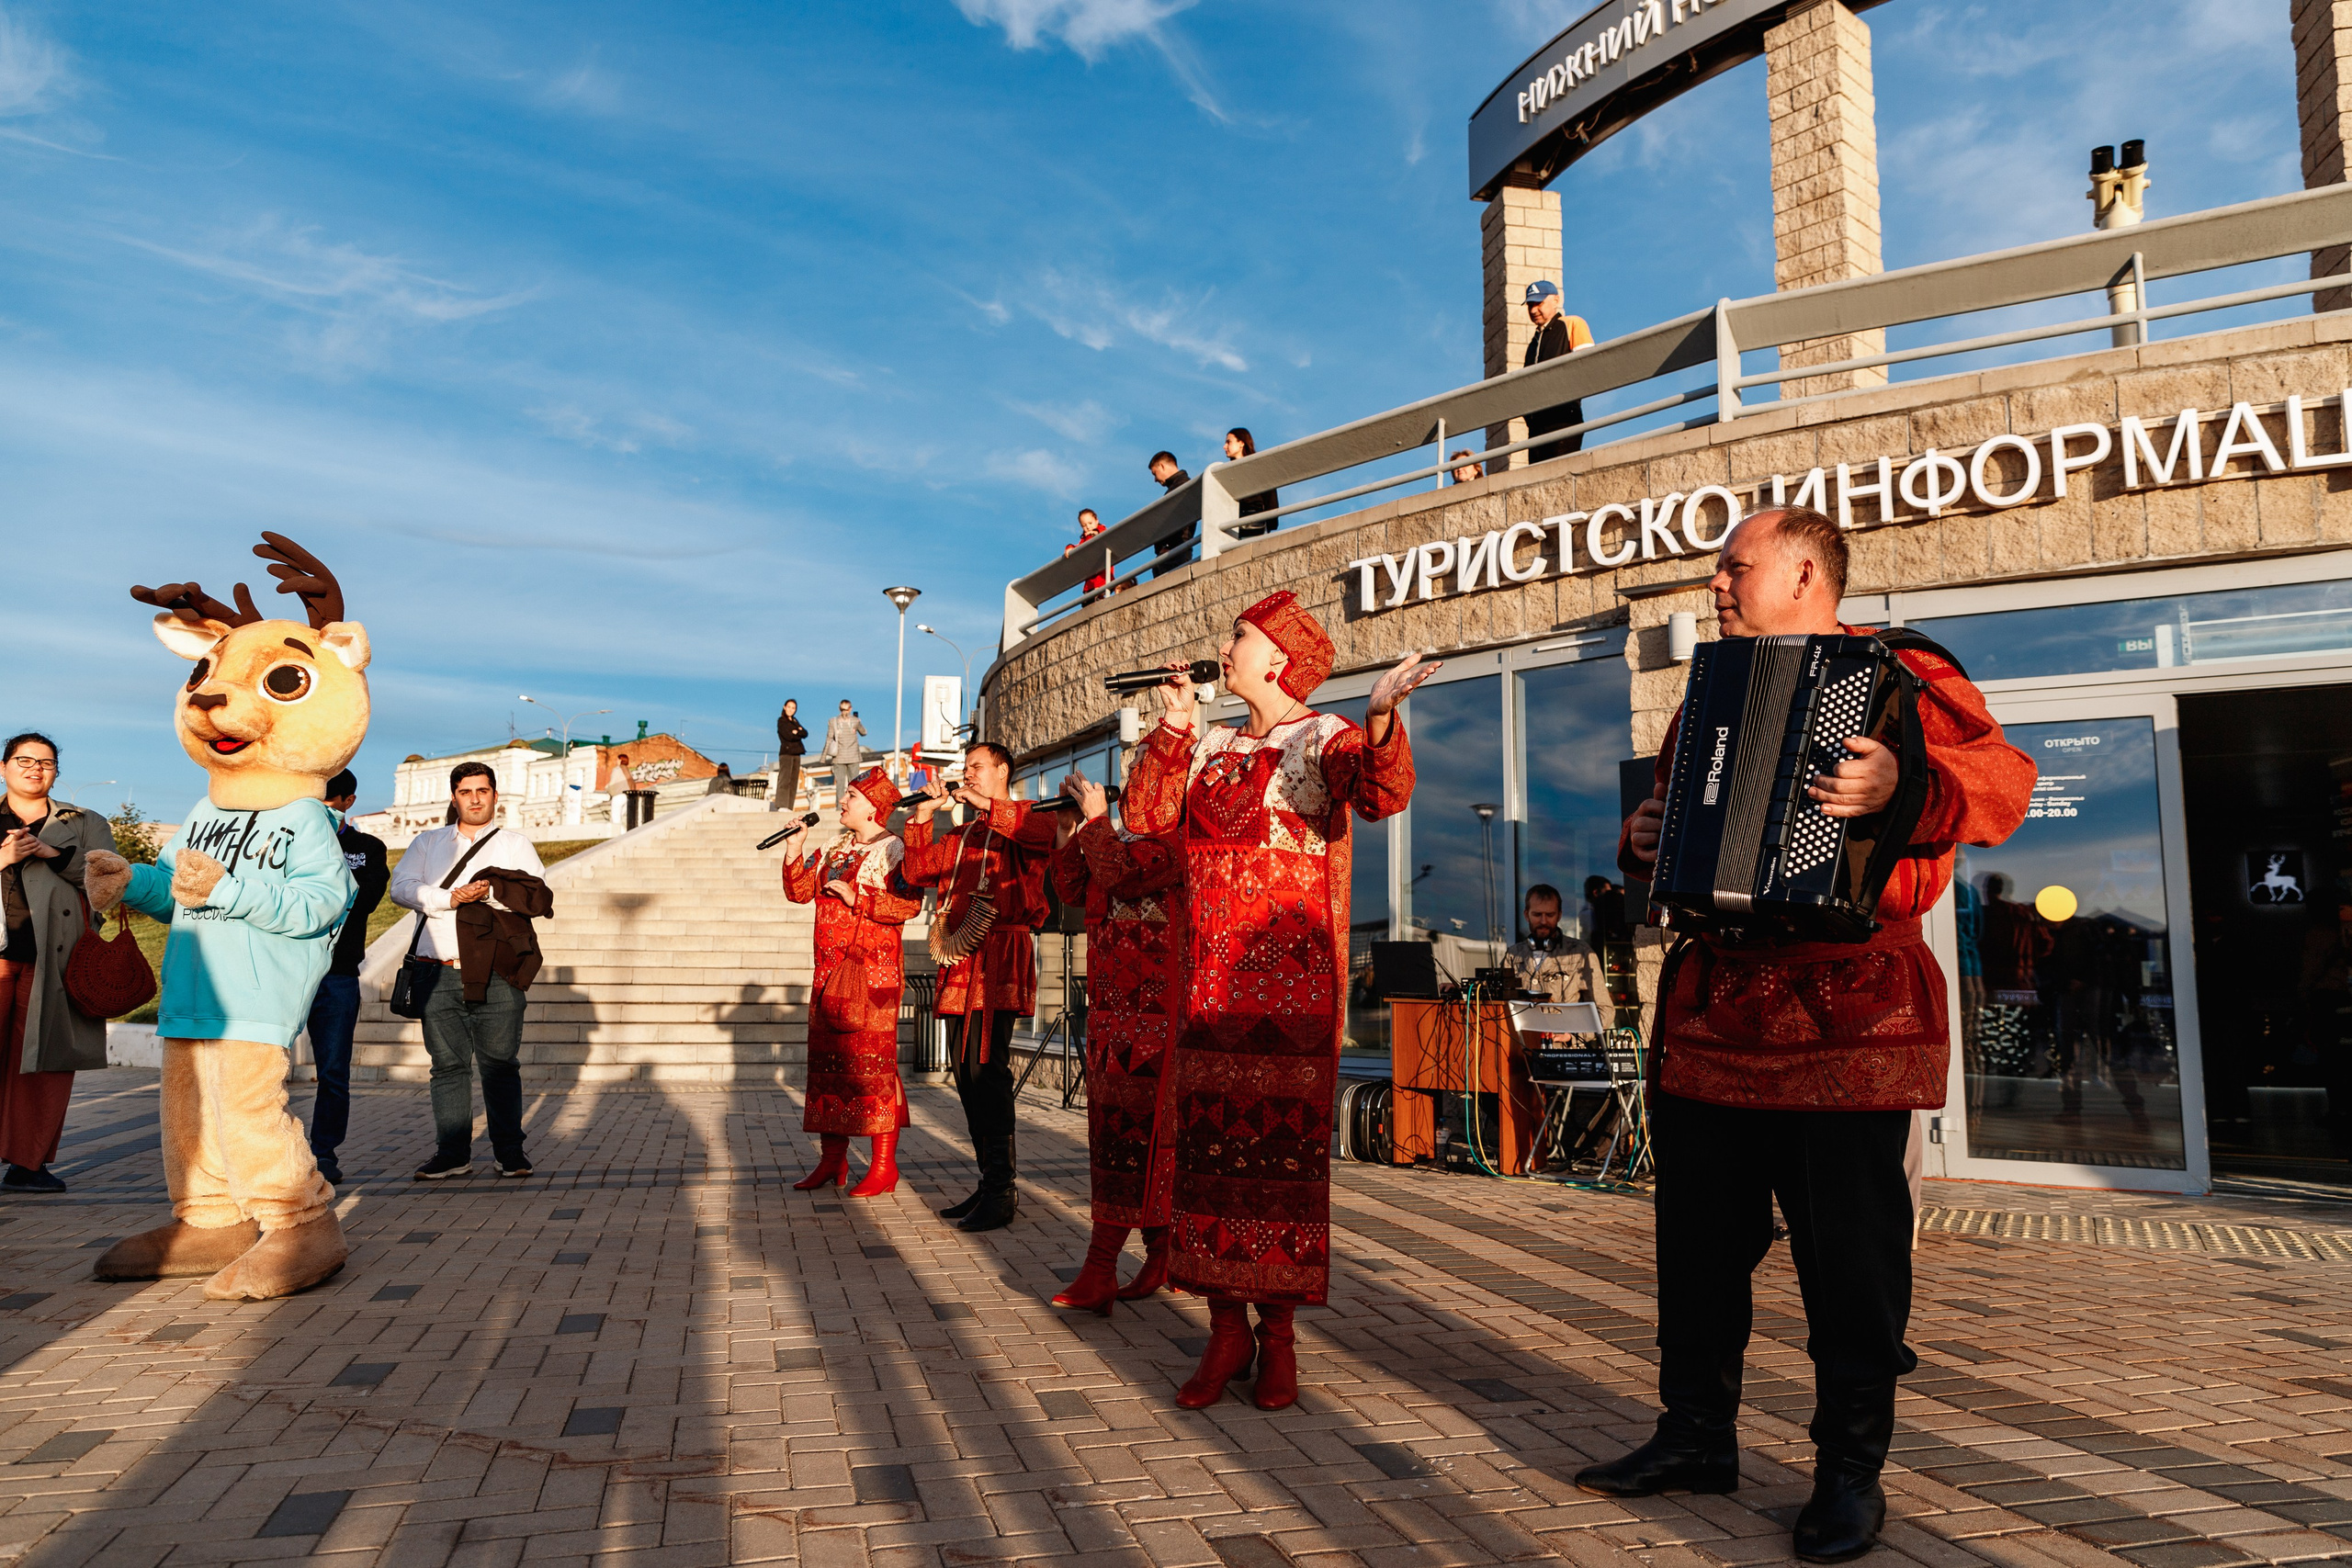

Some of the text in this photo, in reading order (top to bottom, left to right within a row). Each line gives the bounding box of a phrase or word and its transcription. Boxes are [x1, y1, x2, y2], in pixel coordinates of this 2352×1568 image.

[1518, 0, 1662, 123] НИЖНИЙ
[1349, 388, 2352, 614] ТУРИСТСКОИНФОРМАЦ
[1707, 727, 1729, 783] Roland
[2044, 737, 2100, 748] ОТКРЫТО
[2025, 808, 2077, 818] .00-20.00
